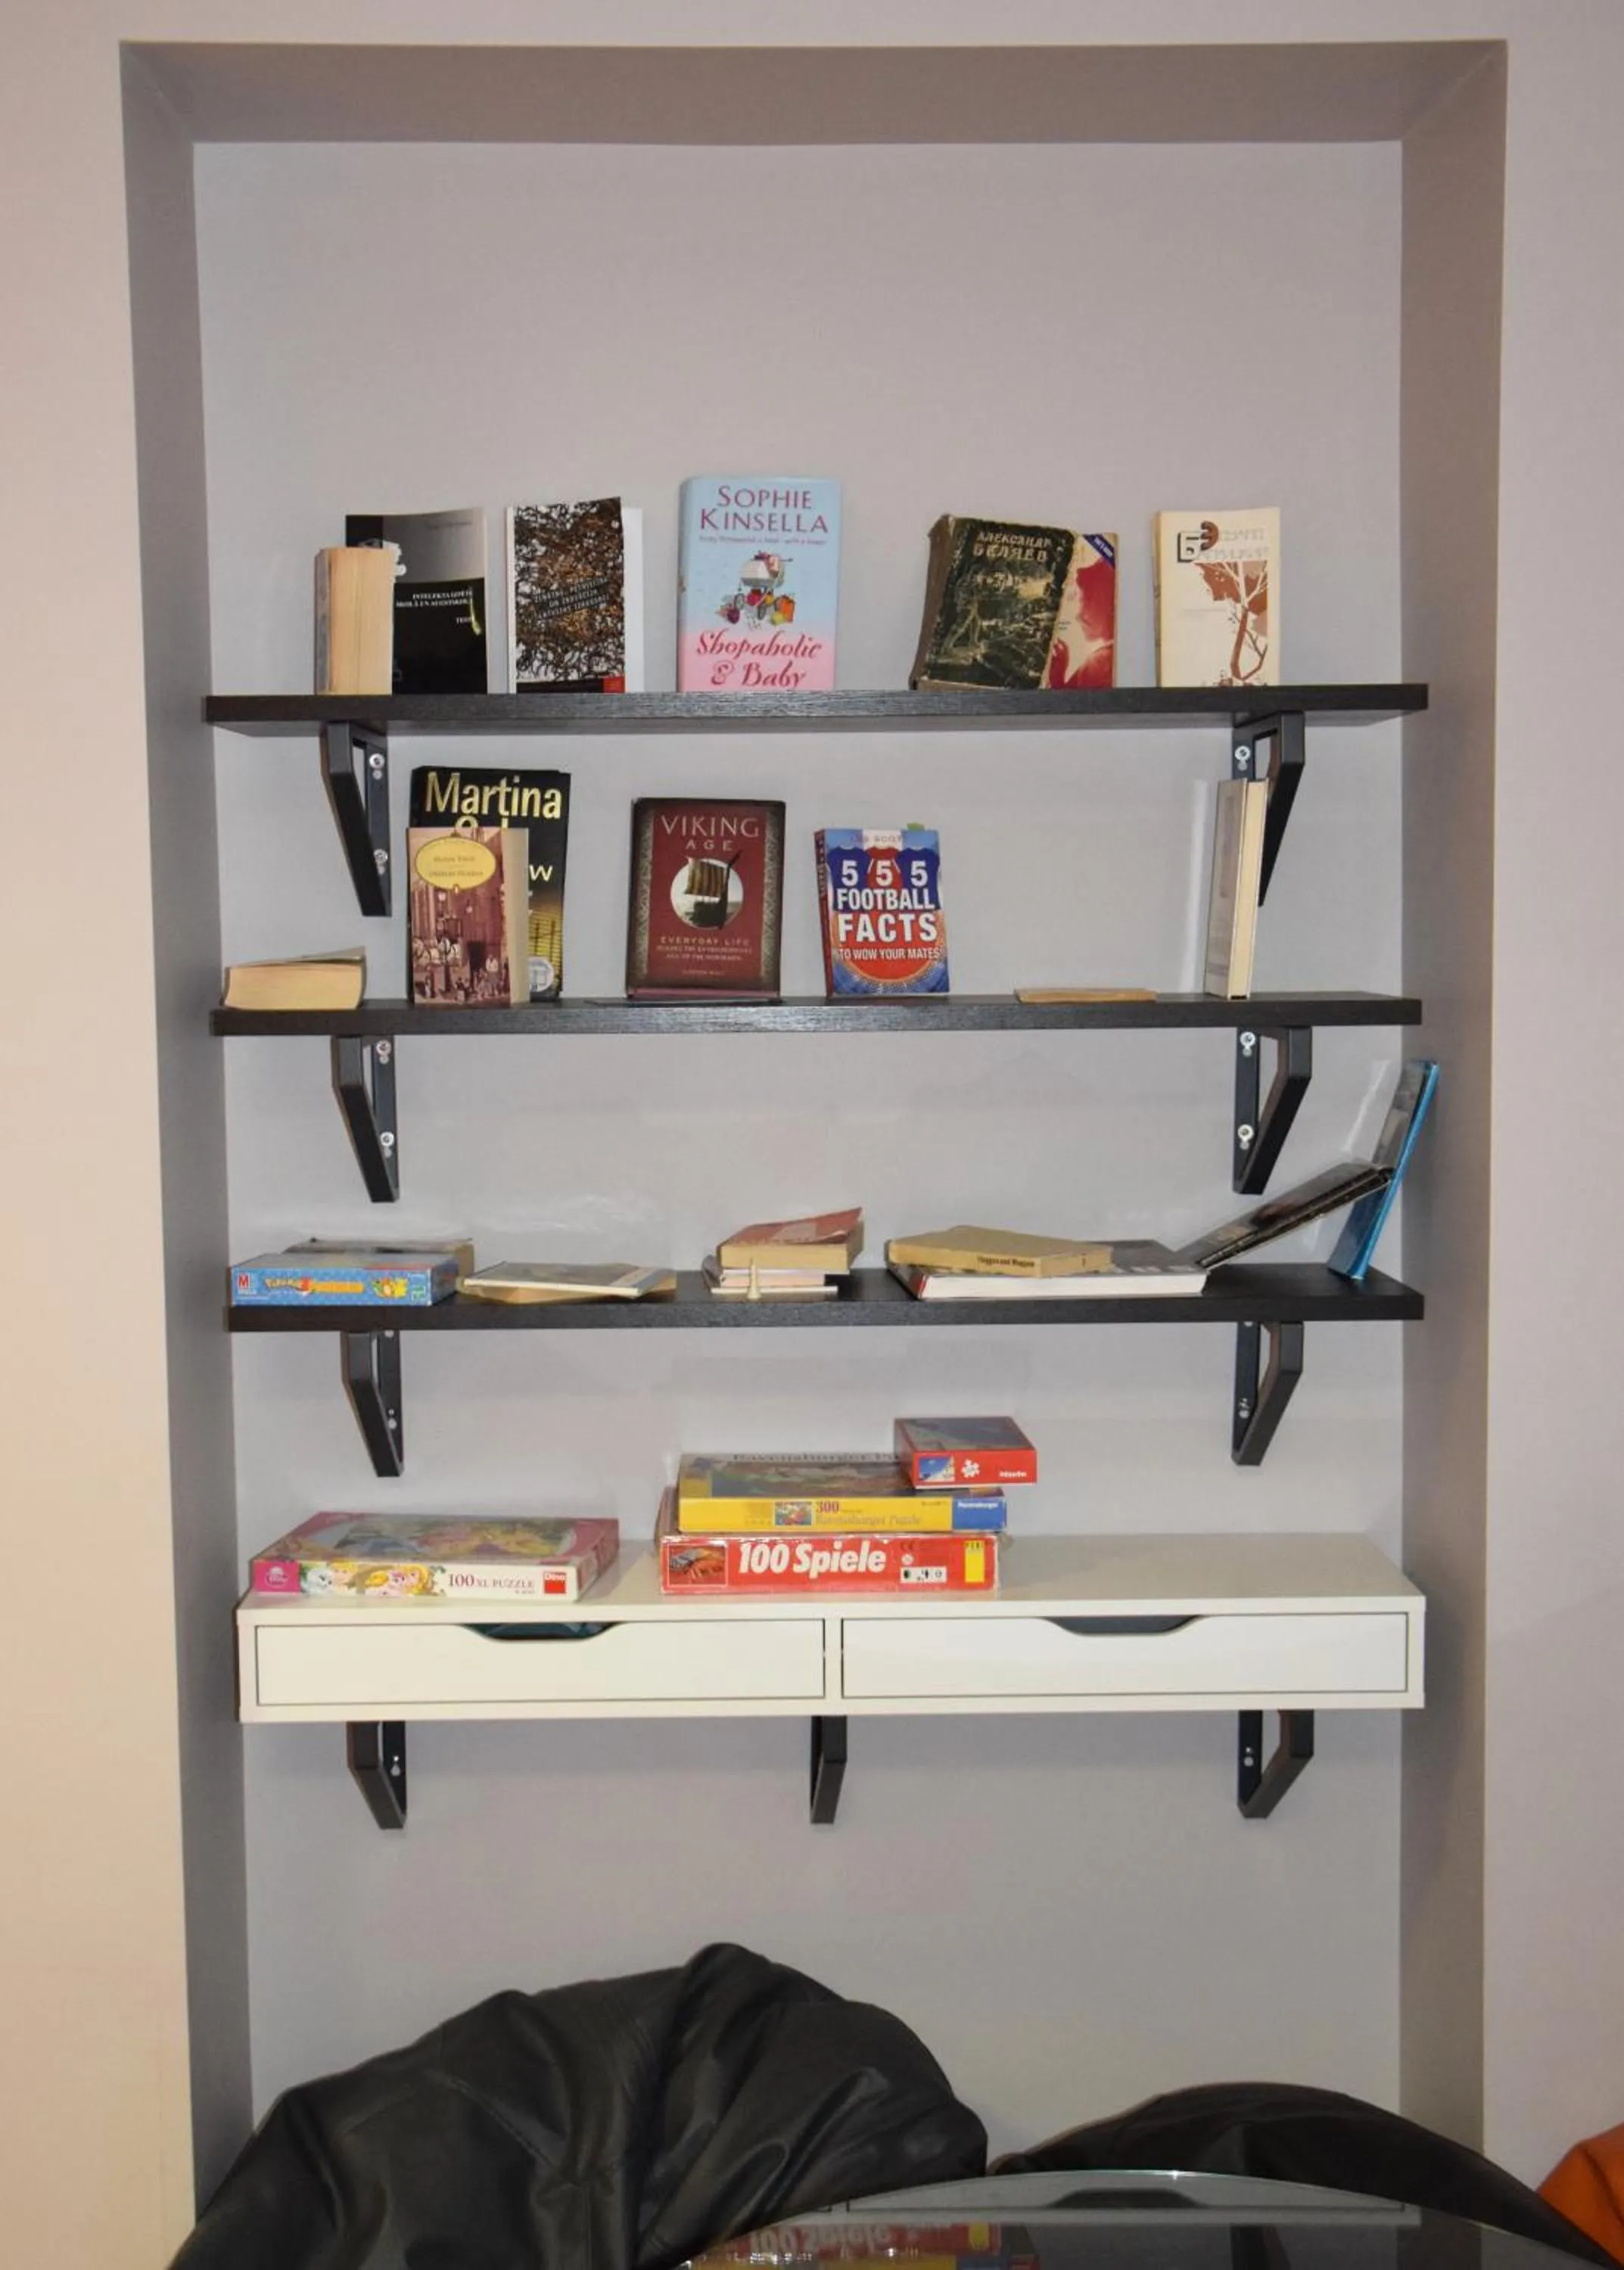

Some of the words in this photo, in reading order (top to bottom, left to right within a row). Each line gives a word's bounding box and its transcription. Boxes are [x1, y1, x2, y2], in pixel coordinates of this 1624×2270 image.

[717, 485, 812, 509] SOPHIE
[700, 508, 829, 533] KINSELLA
[696, 628, 823, 660] Shopaholic
[741, 661, 807, 688] Baby
[425, 771, 562, 819] Martina
[661, 815, 760, 838] VIKING
[685, 839, 733, 852] AGE
[836, 888, 935, 910] FOOTBALL
[838, 913, 938, 942] FACTS
[660, 936, 719, 946] EVERYDAY
[723, 938, 751, 947] LIFE
[853, 947, 877, 960] WOW
[879, 947, 906, 959] YOUR
[816, 1500, 840, 1514] 300
[739, 1542, 790, 1575] 100
[792, 1540, 887, 1579] Spiele
[448, 1573, 474, 1587] 100
[492, 1578, 535, 1588] PUZZLE
